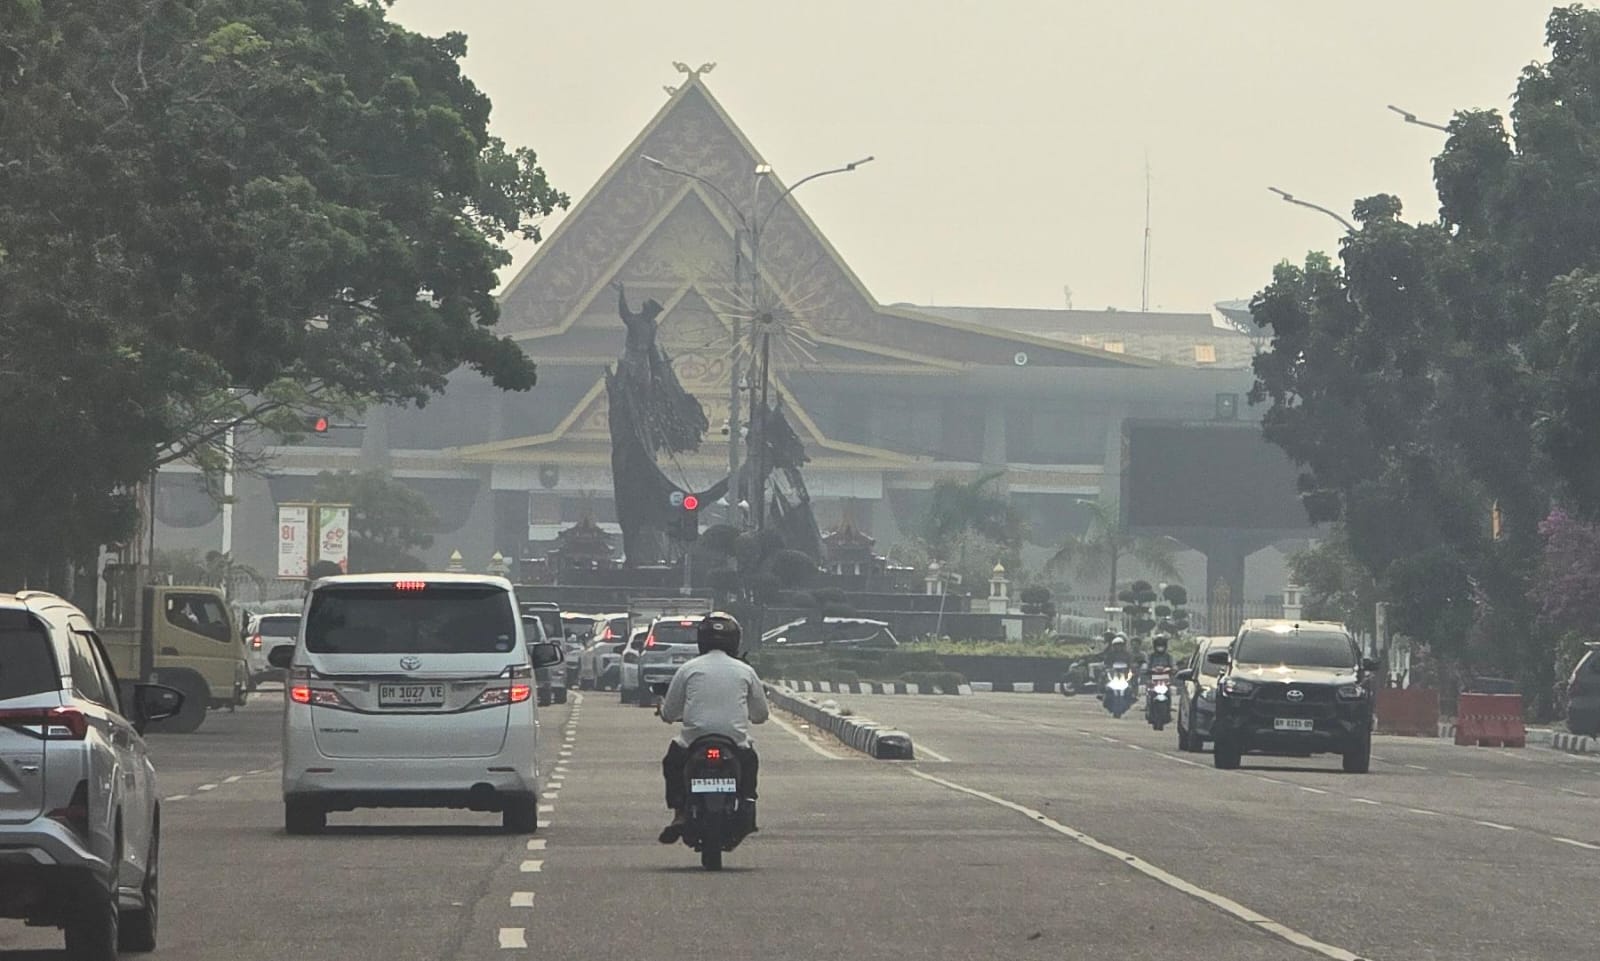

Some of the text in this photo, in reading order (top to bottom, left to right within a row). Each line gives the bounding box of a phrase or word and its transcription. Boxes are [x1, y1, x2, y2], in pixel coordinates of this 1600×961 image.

[382, 686, 442, 698] BM 1027 VE
